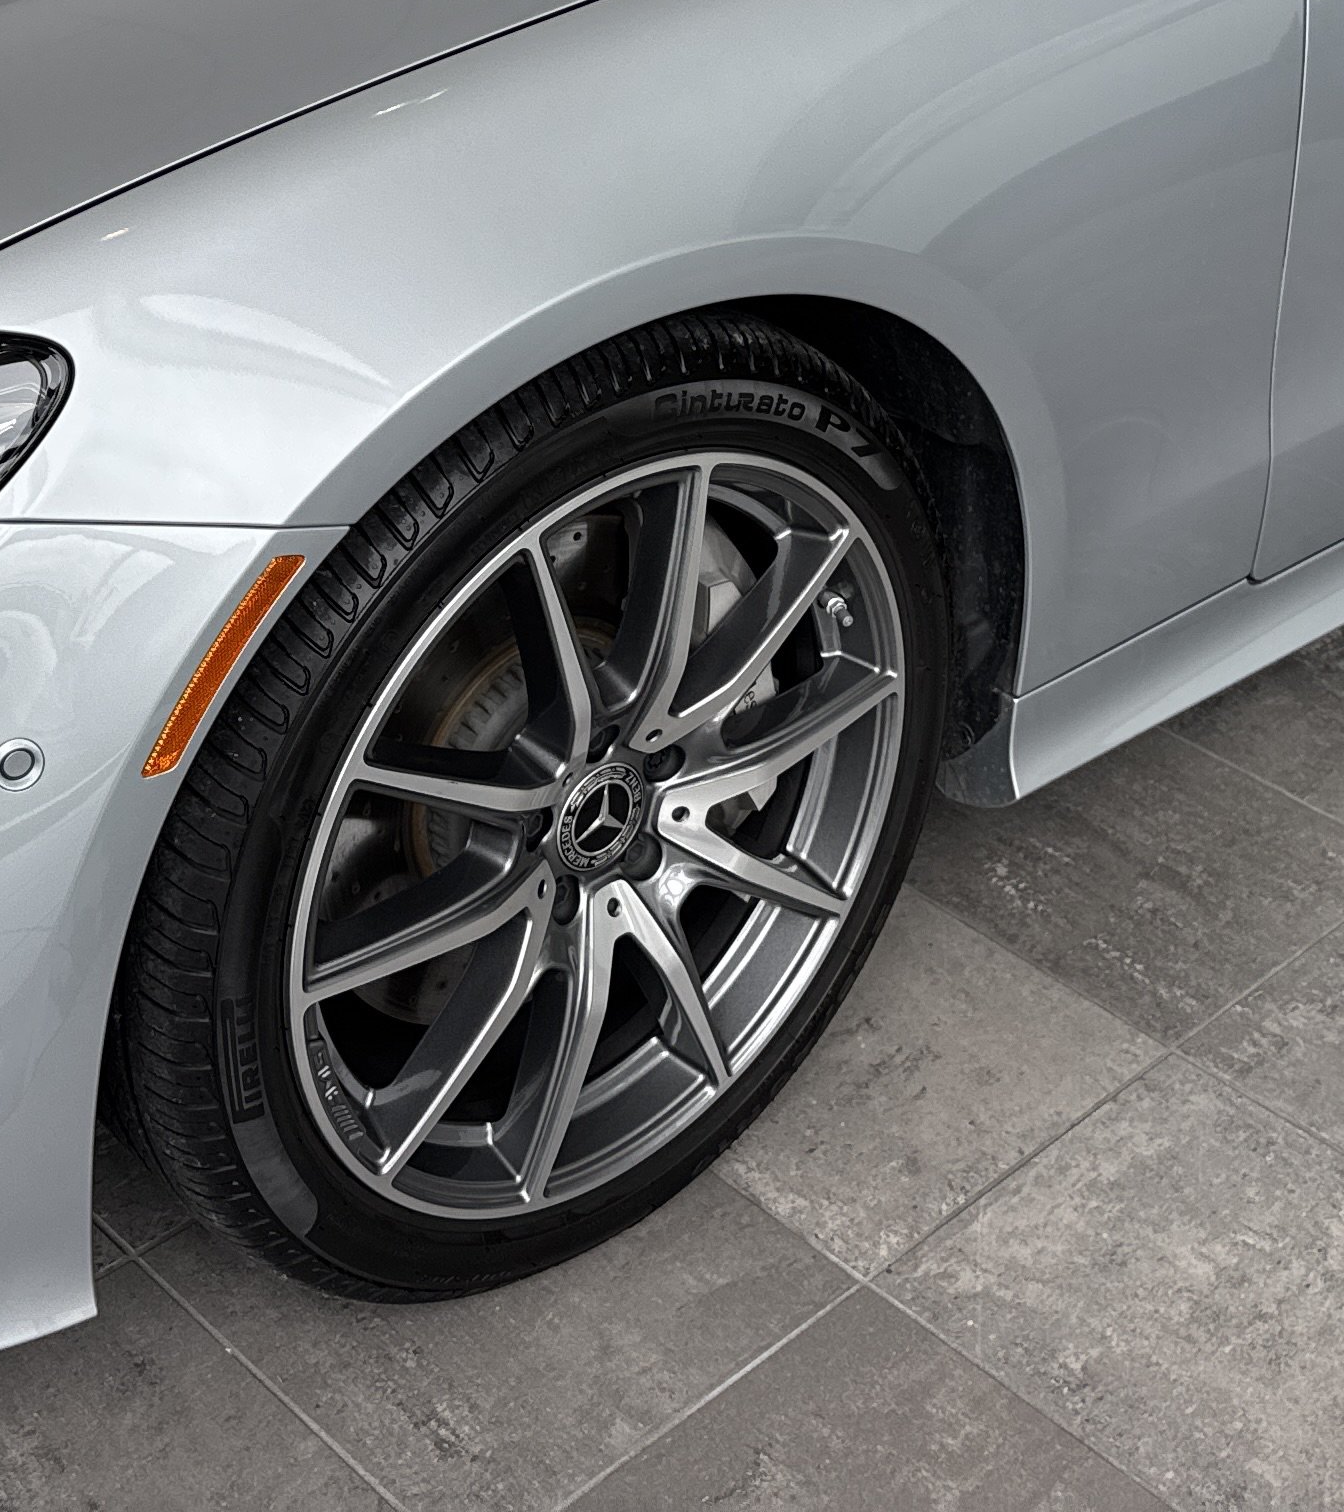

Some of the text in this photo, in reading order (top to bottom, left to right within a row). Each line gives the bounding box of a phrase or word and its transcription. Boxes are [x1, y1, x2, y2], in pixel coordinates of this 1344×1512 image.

[655, 390, 882, 458] Cinturato P7
[624, 771, 642, 803] BENZ
[561, 815, 591, 867] MERCEDES
[220, 998, 265, 1124] PIRELLI
